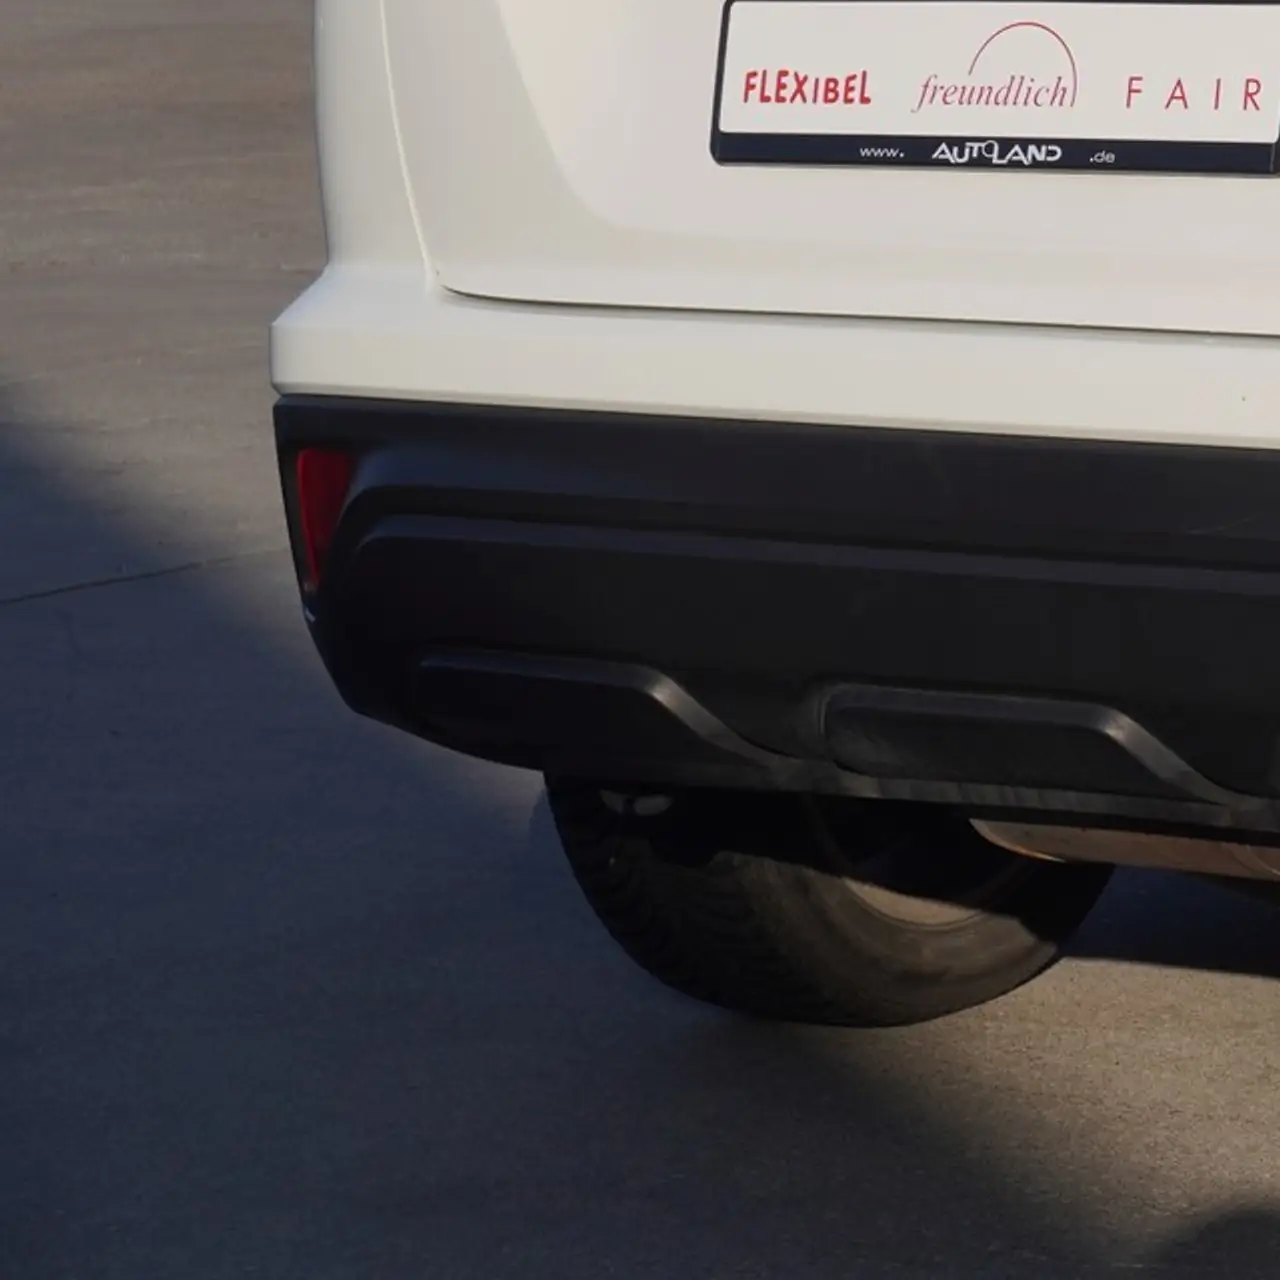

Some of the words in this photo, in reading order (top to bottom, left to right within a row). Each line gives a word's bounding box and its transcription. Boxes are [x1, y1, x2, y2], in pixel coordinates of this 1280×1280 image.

[743, 69, 872, 106] FLEXIBEL
[910, 74, 1069, 113] freundlich
[859, 146, 905, 160] www.
[931, 139, 1063, 166] AUTOLAND
[1089, 150, 1116, 164] .de
